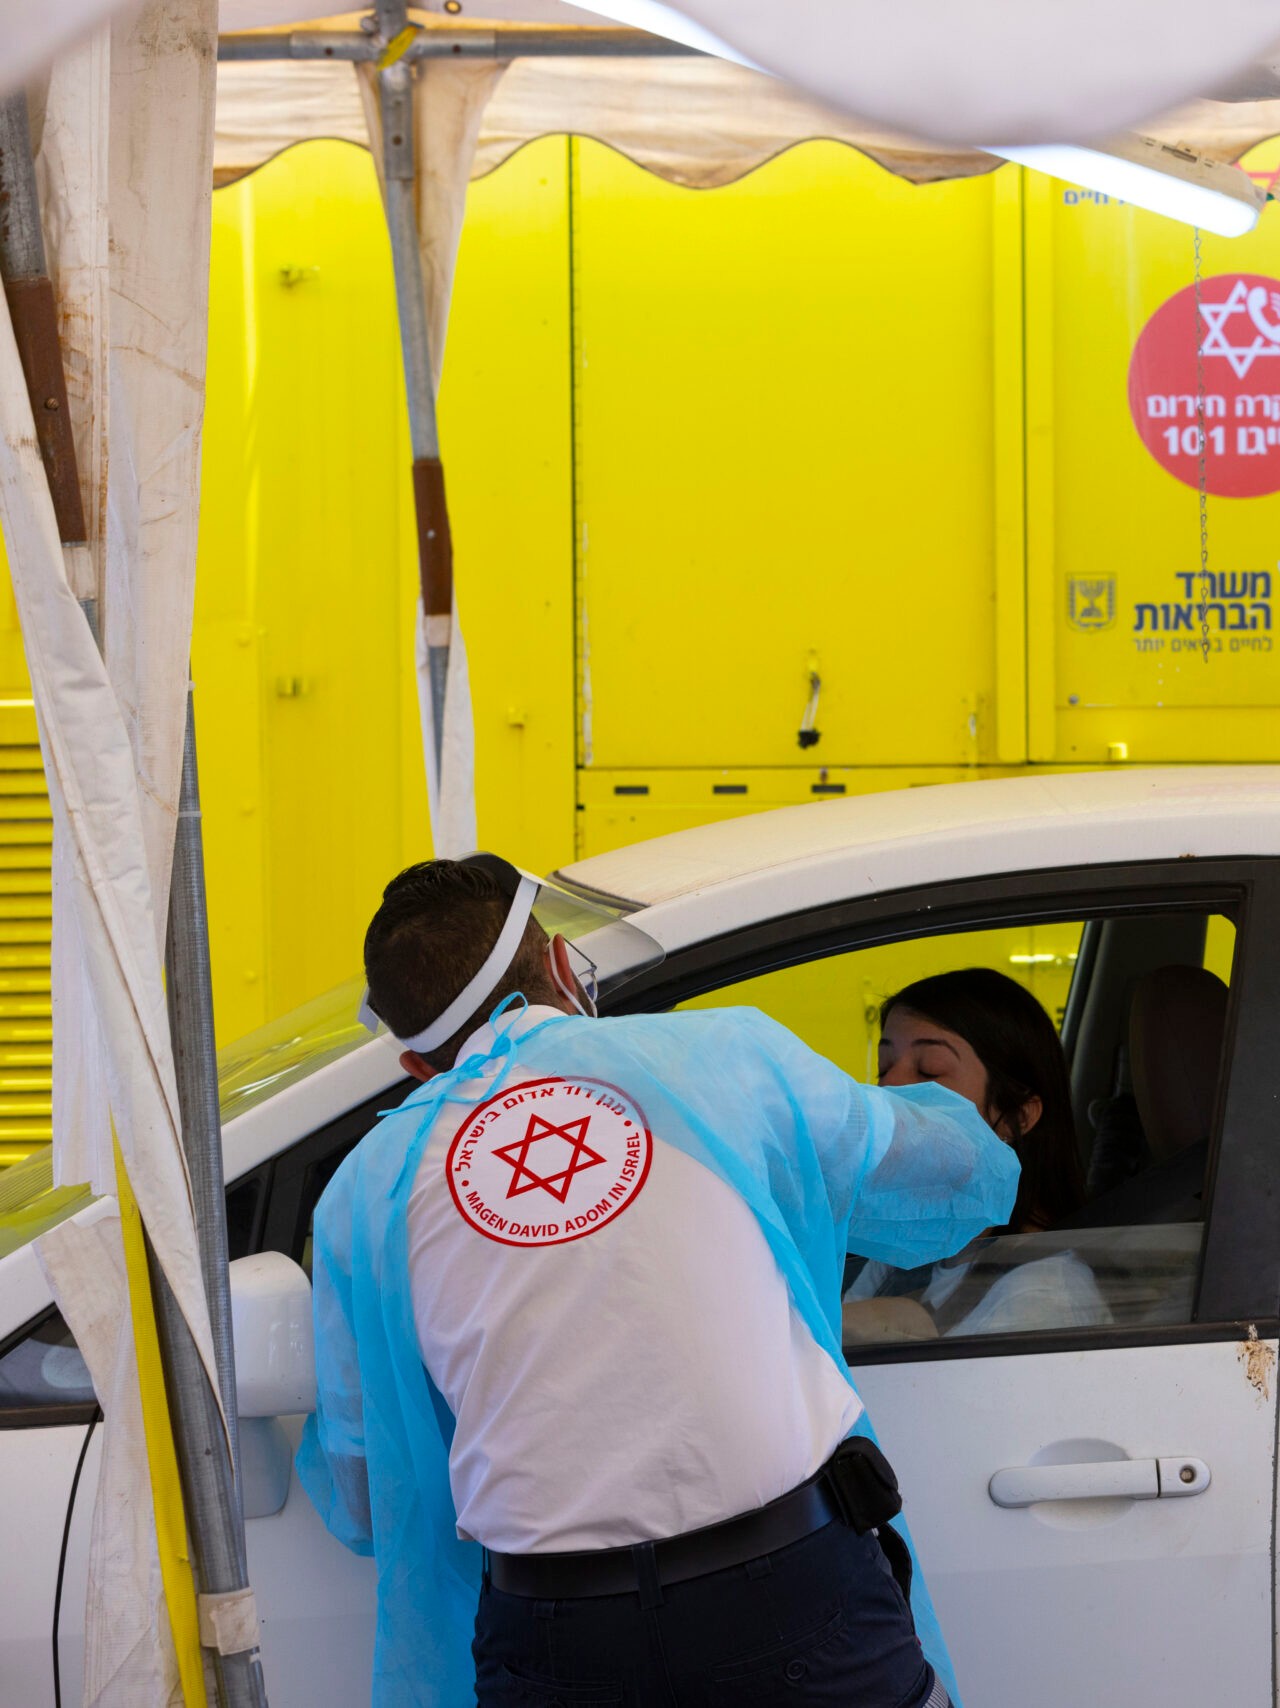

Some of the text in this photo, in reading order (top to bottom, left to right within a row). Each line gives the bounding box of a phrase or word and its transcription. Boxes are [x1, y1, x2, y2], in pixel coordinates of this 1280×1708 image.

[1146, 394, 1226, 418] חירום
[1163, 425, 1225, 455] 101
[1174, 571, 1272, 600] משרד
[1133, 602, 1272, 631] הבריאות
[1133, 638, 1165, 652] יותר
[1229, 635, 1273, 652] לחיים
[454, 1086, 627, 1172] מגן דוד אדום בישראל
[465, 1131, 641, 1238] MAGEN DAVID ADOM IN ISRAEL
